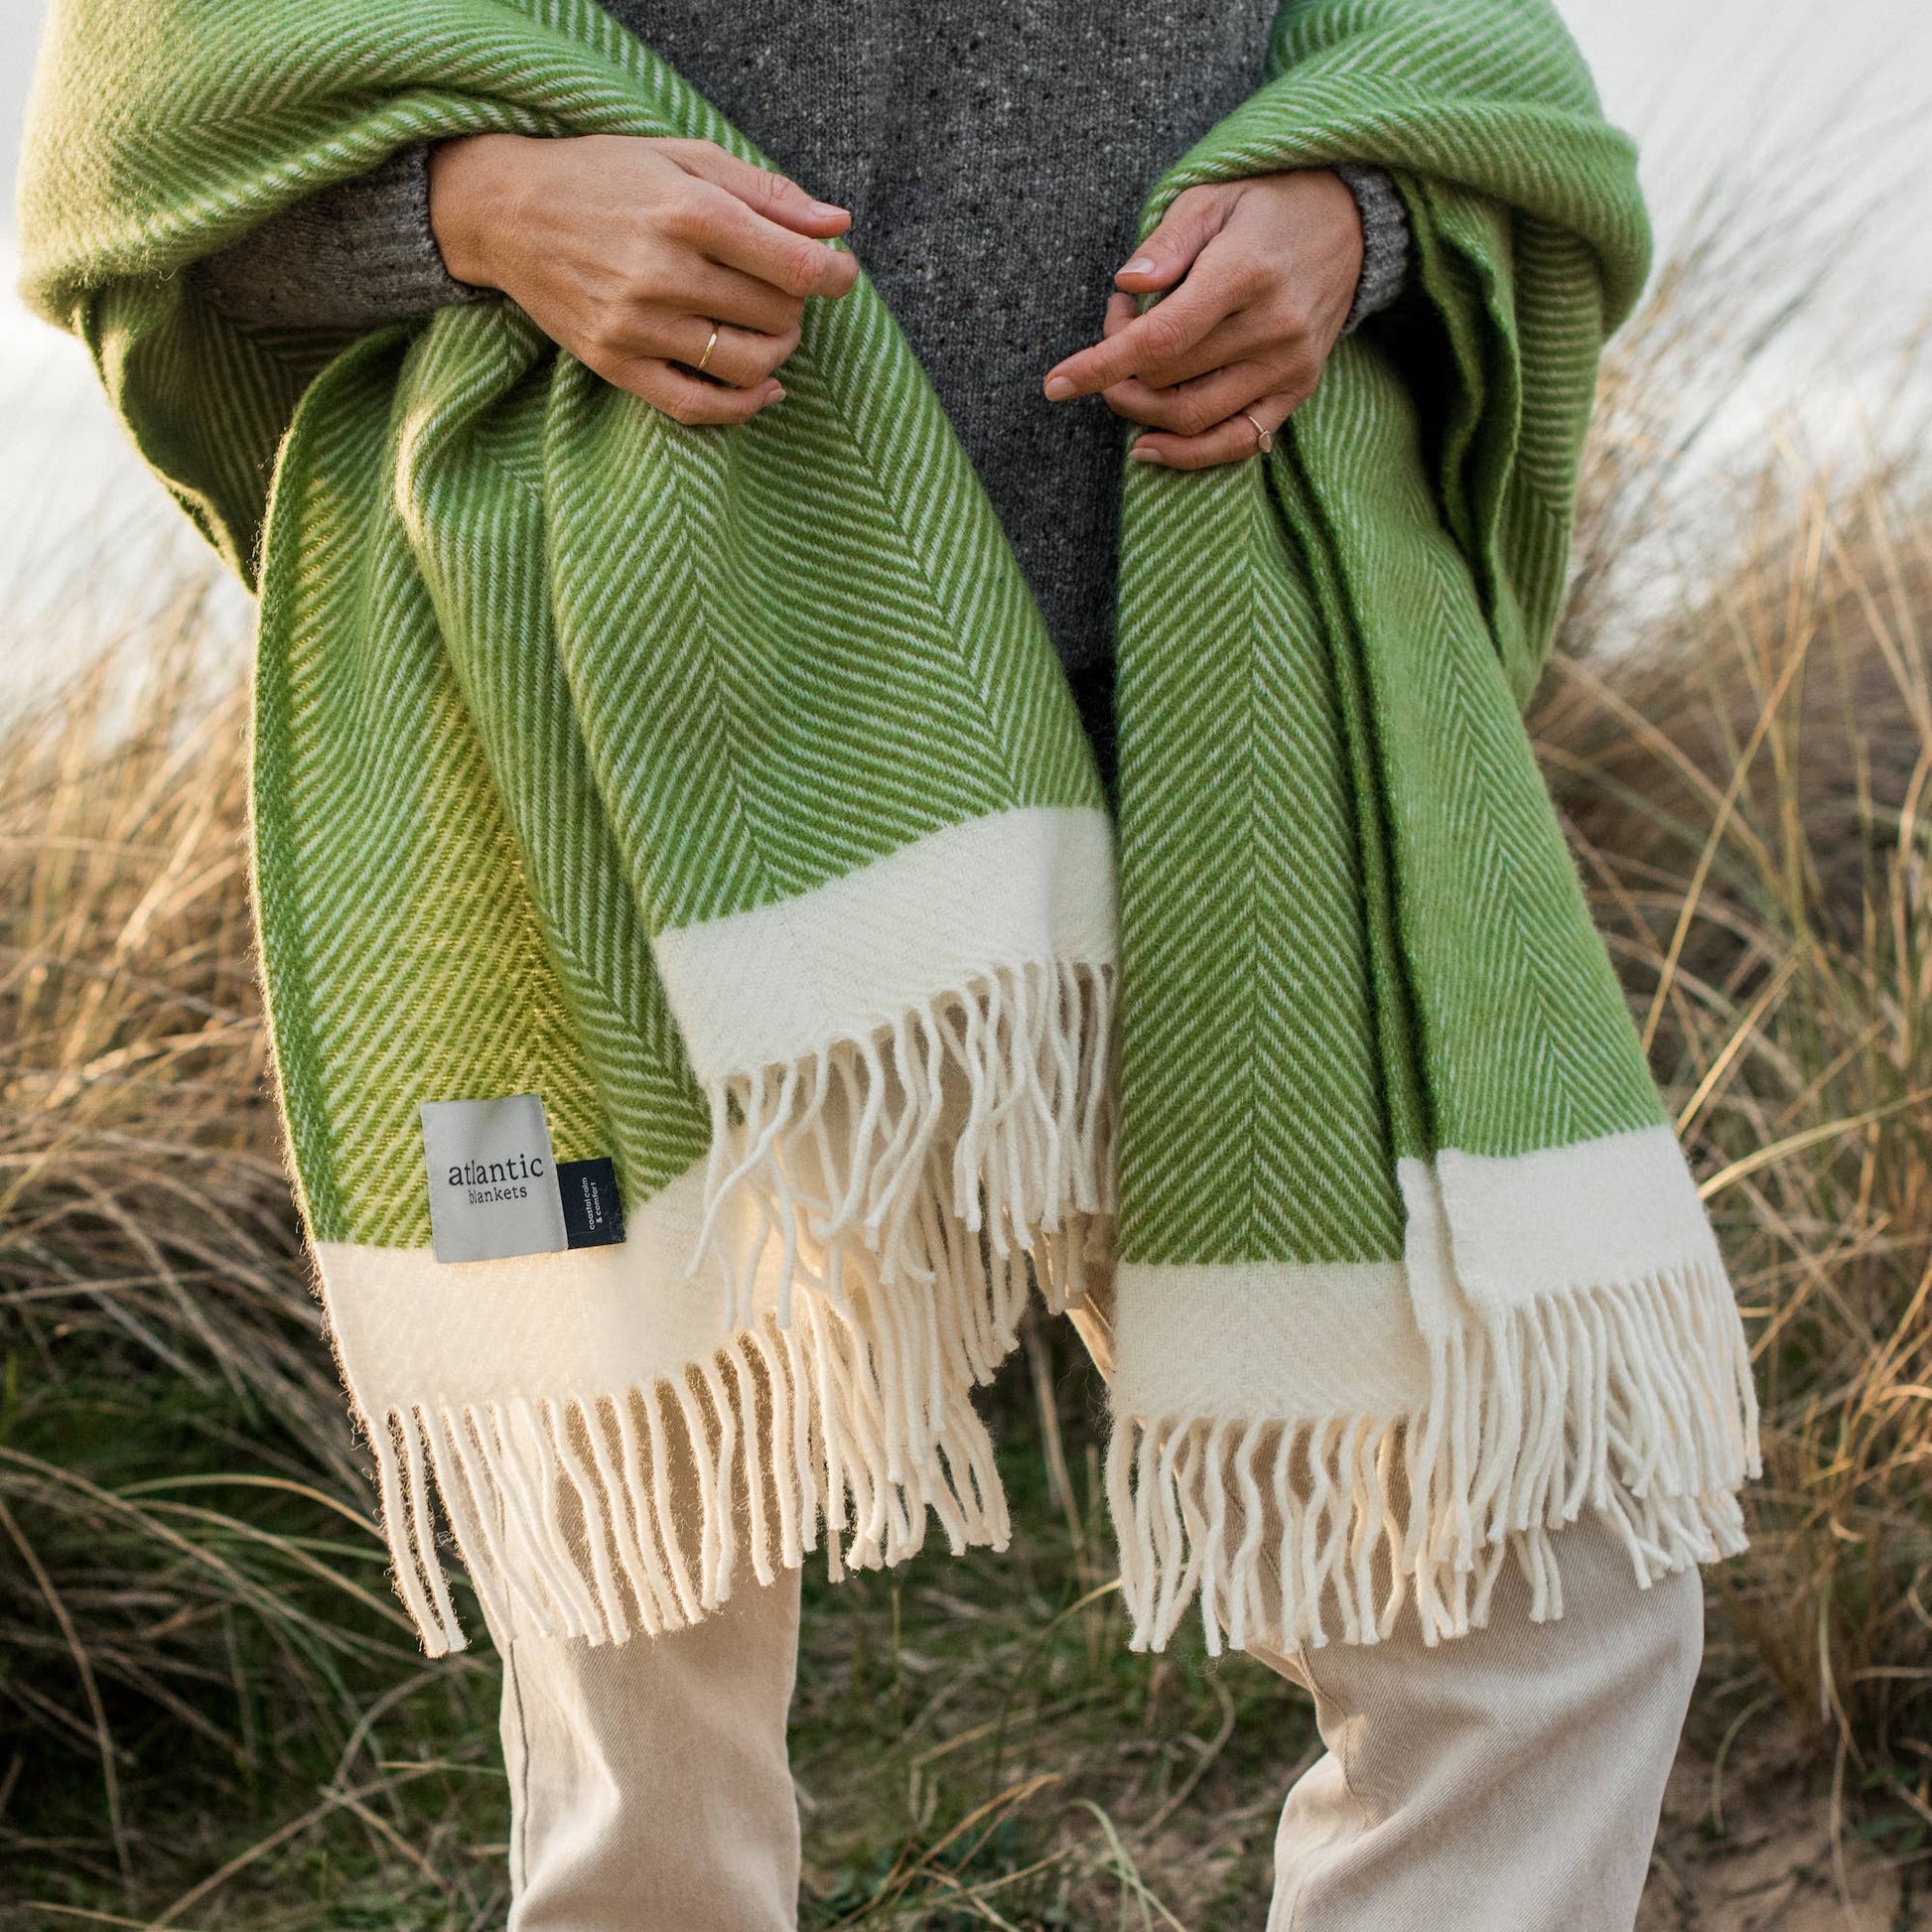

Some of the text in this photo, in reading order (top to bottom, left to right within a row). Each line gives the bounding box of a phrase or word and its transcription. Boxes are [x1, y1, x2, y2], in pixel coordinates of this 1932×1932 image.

[449, 1153, 544, 1186] atlantic
[469, 1186, 527, 1204] blankets
[581, 1176, 595, 1230] coastal calm
[590, 1181, 602, 1216] comfort
